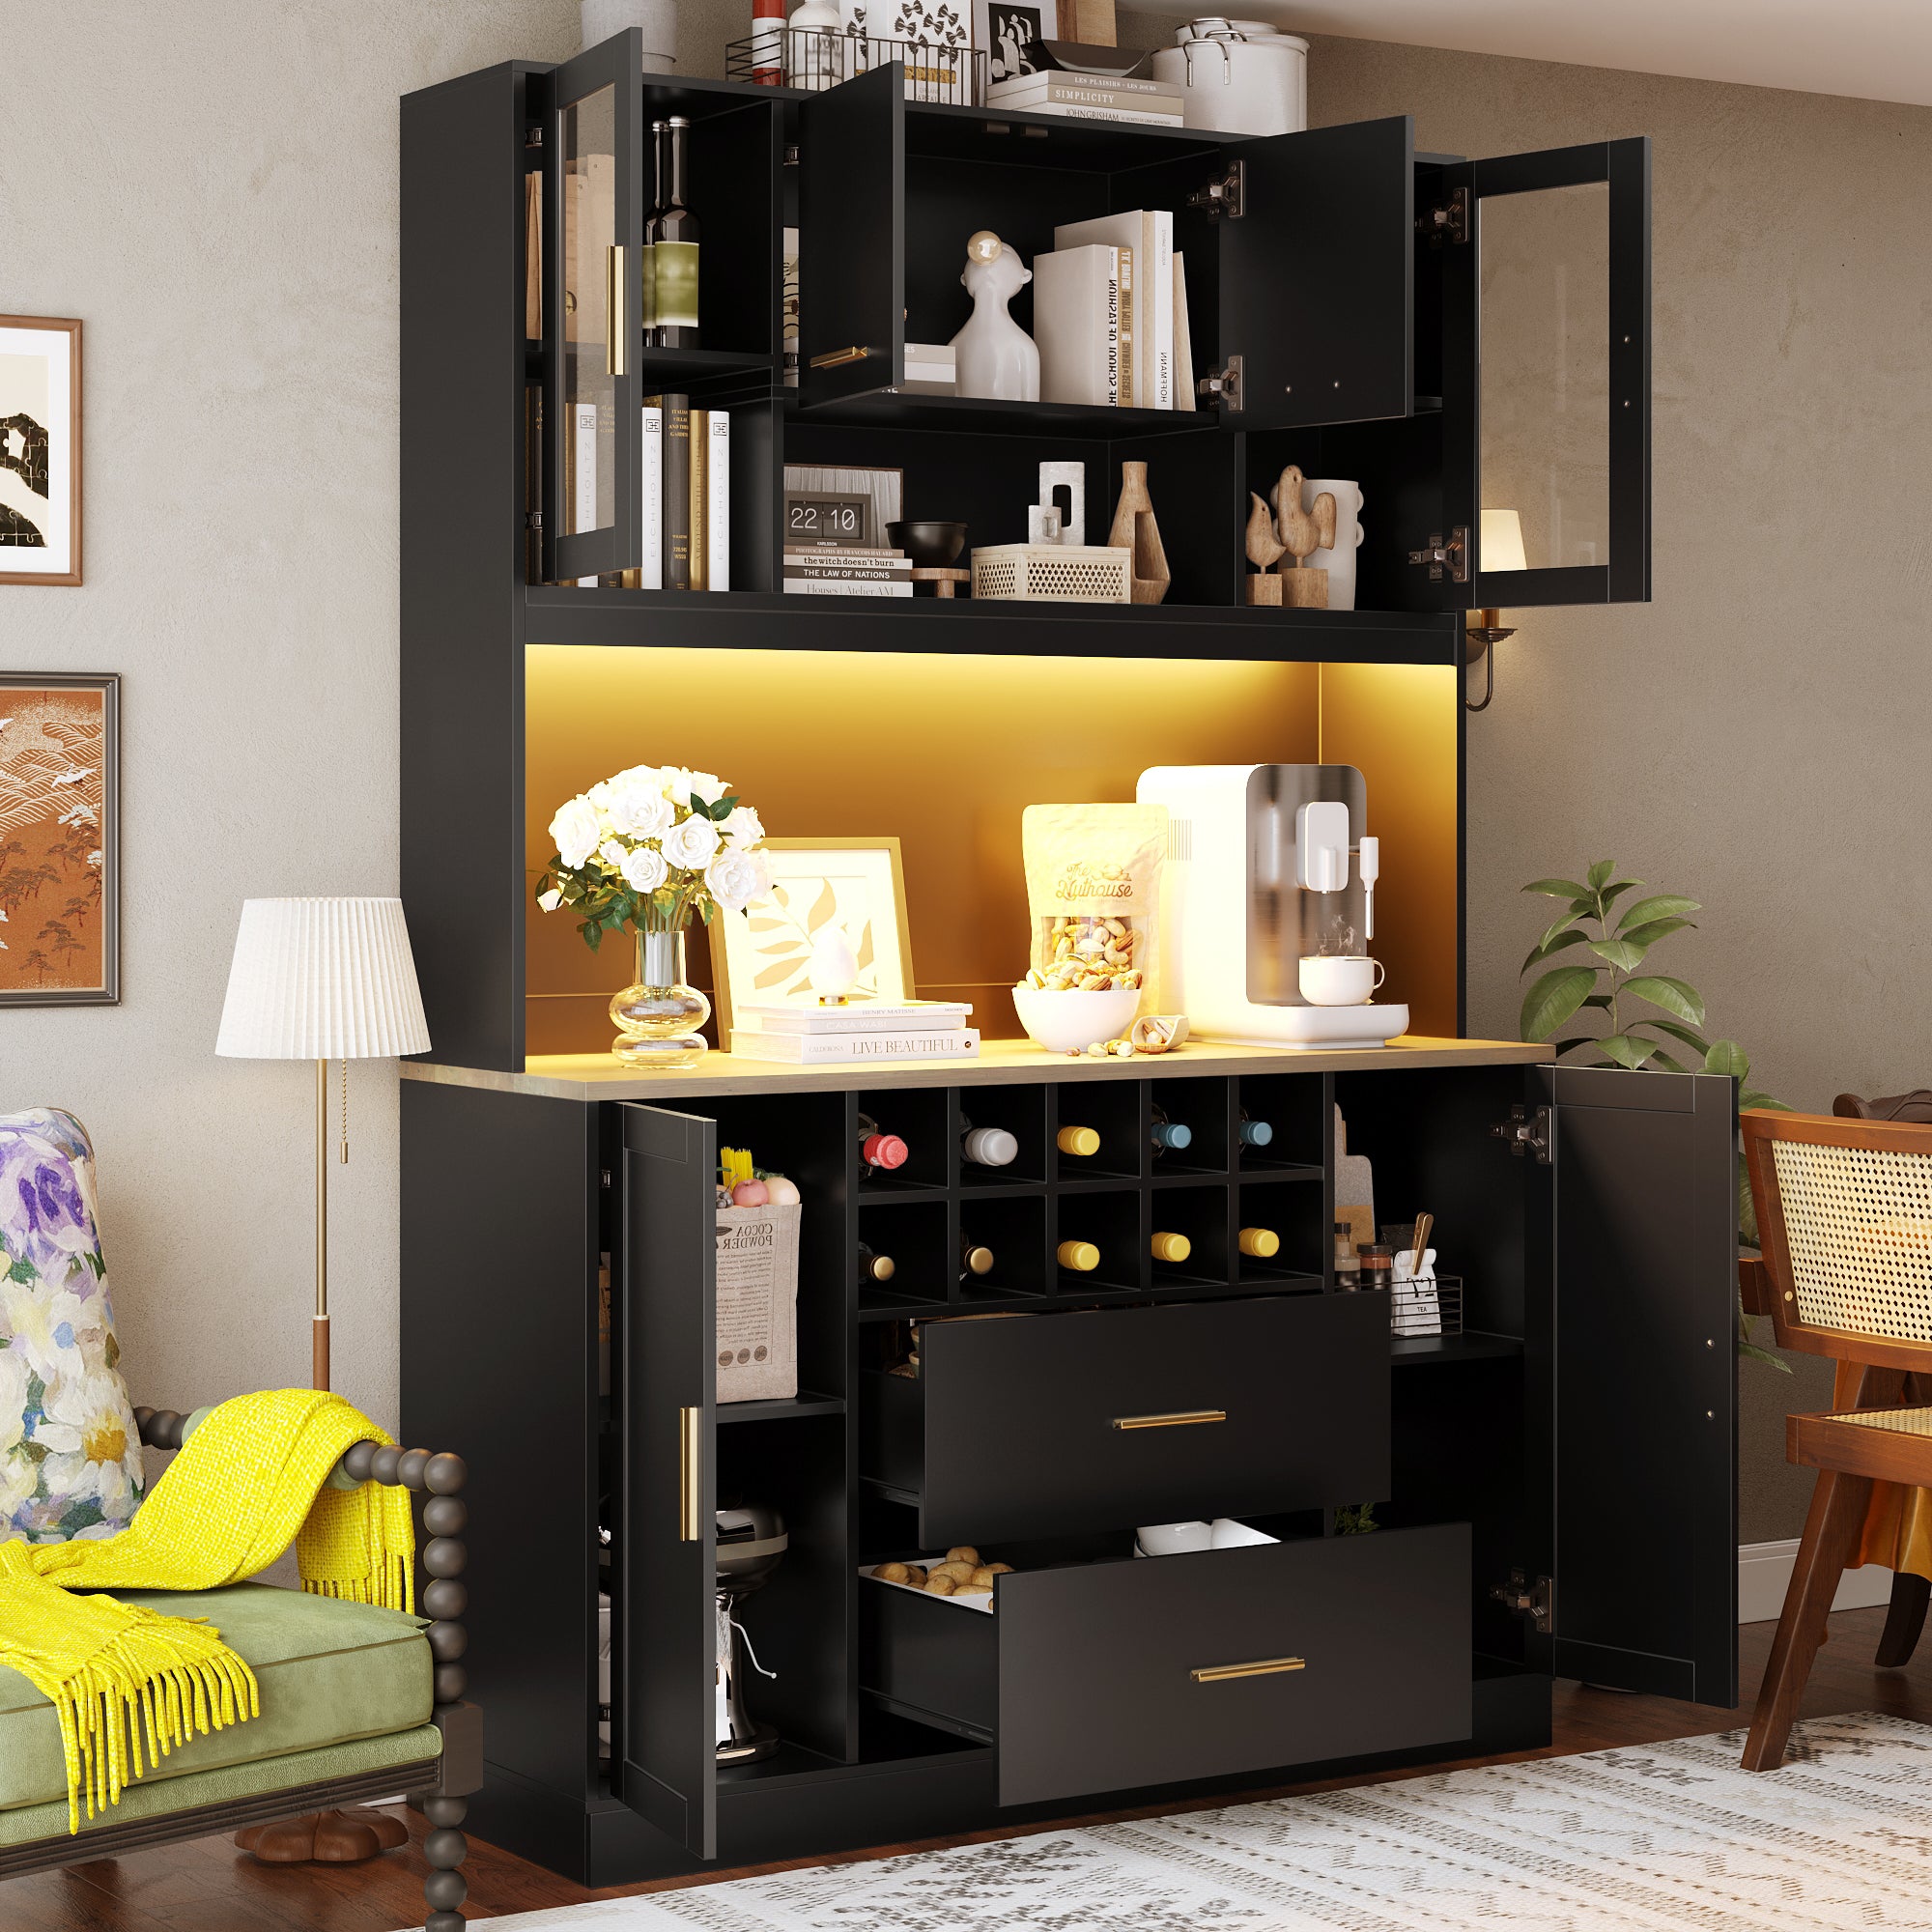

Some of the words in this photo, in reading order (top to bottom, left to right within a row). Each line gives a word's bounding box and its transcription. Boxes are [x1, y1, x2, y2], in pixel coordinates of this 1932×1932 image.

[1055, 89, 1115, 103] SIMPLICITY
[1086, 110, 1120, 122] GRISHAM
[791, 507, 818, 529] 22
[830, 508, 856, 530] 10
[804, 556, 818, 565] the
[874, 558, 895, 567] burn
[855, 570, 891, 579] NATIONS
[807, 583, 838, 595] Houses
[845, 585, 874, 595] Atelier
[1066, 862, 1091, 880] The
[1055, 877, 1133, 901] Nuthouse
[826, 1021, 858, 1030] CASA
[852, 1041, 884, 1055] LIVE
[886, 1038, 958, 1053] BEAUTIFUL
